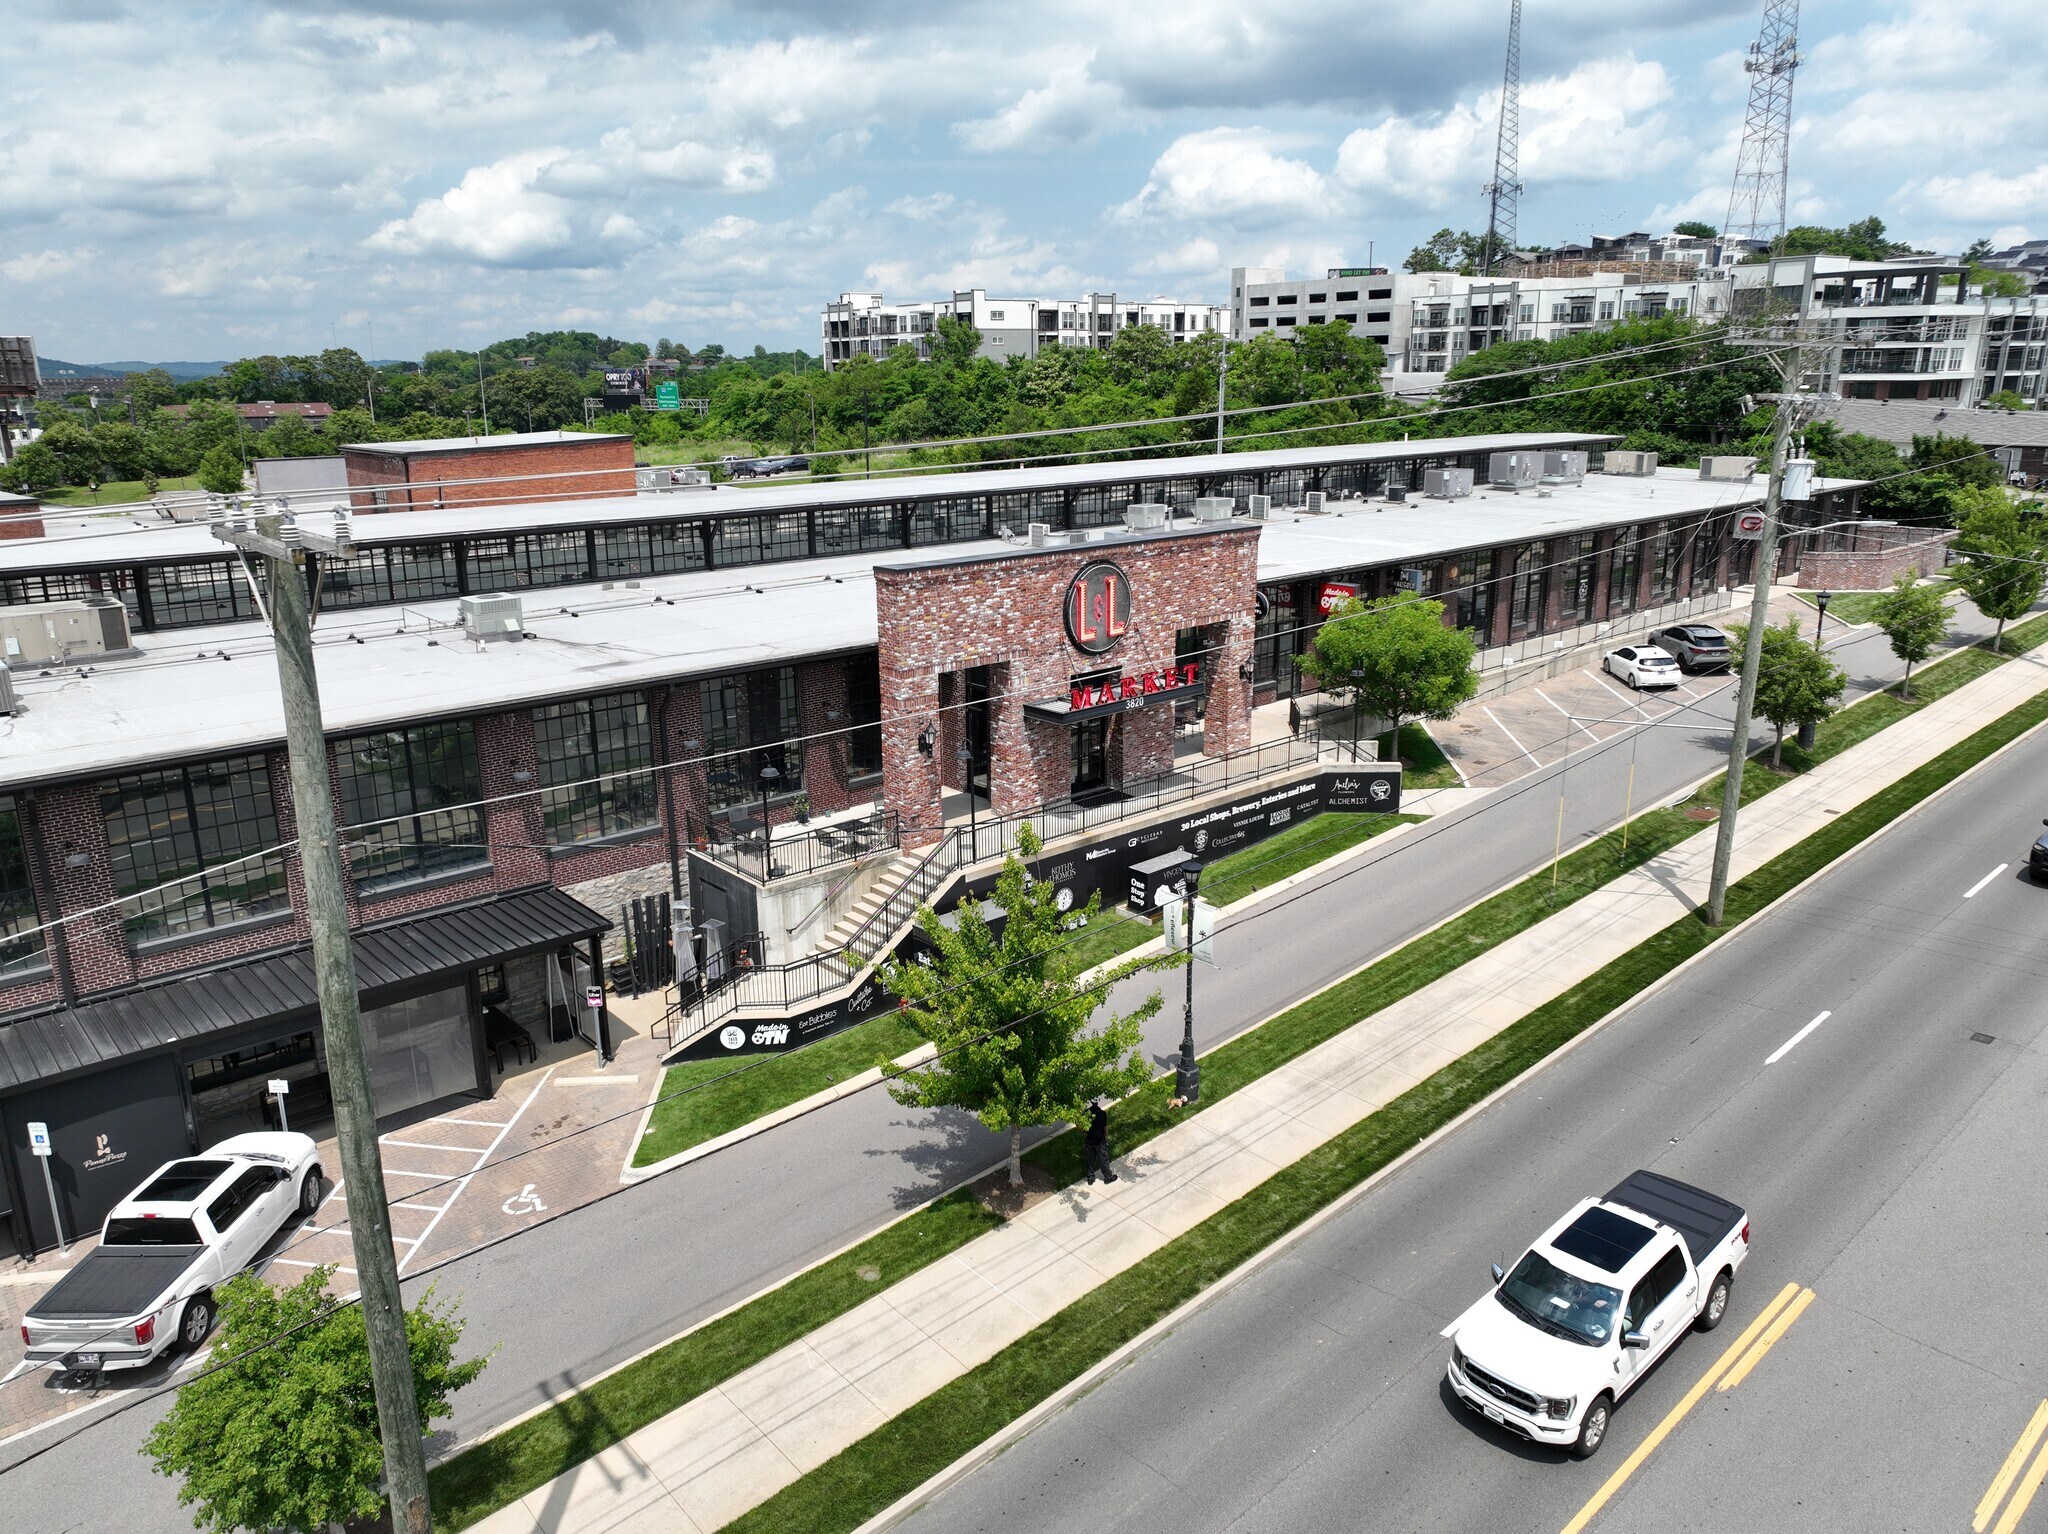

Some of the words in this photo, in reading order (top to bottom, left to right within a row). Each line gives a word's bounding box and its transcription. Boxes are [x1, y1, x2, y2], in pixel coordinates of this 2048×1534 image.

[1069, 663, 1199, 711] MARKET
[1125, 697, 1144, 709] 3820
[1296, 798, 1319, 810] CATALYST
[1329, 797, 1368, 805] ALCHEMIST
[1180, 822, 1190, 831] 30
[1190, 815, 1209, 828] Local
[1209, 810, 1231, 821] Shops,
[1232, 801, 1261, 814] Brewery,
[1261, 792, 1287, 806] Eateries
[1287, 786, 1300, 797] and
[1300, 783, 1316, 793] More
[1131, 878, 1145, 889] One
[1131, 887, 1145, 898] Stop
[1131, 895, 1145, 906] Shop
[755, 1023, 779, 1033] Made
[763, 1029, 791, 1045] TN
